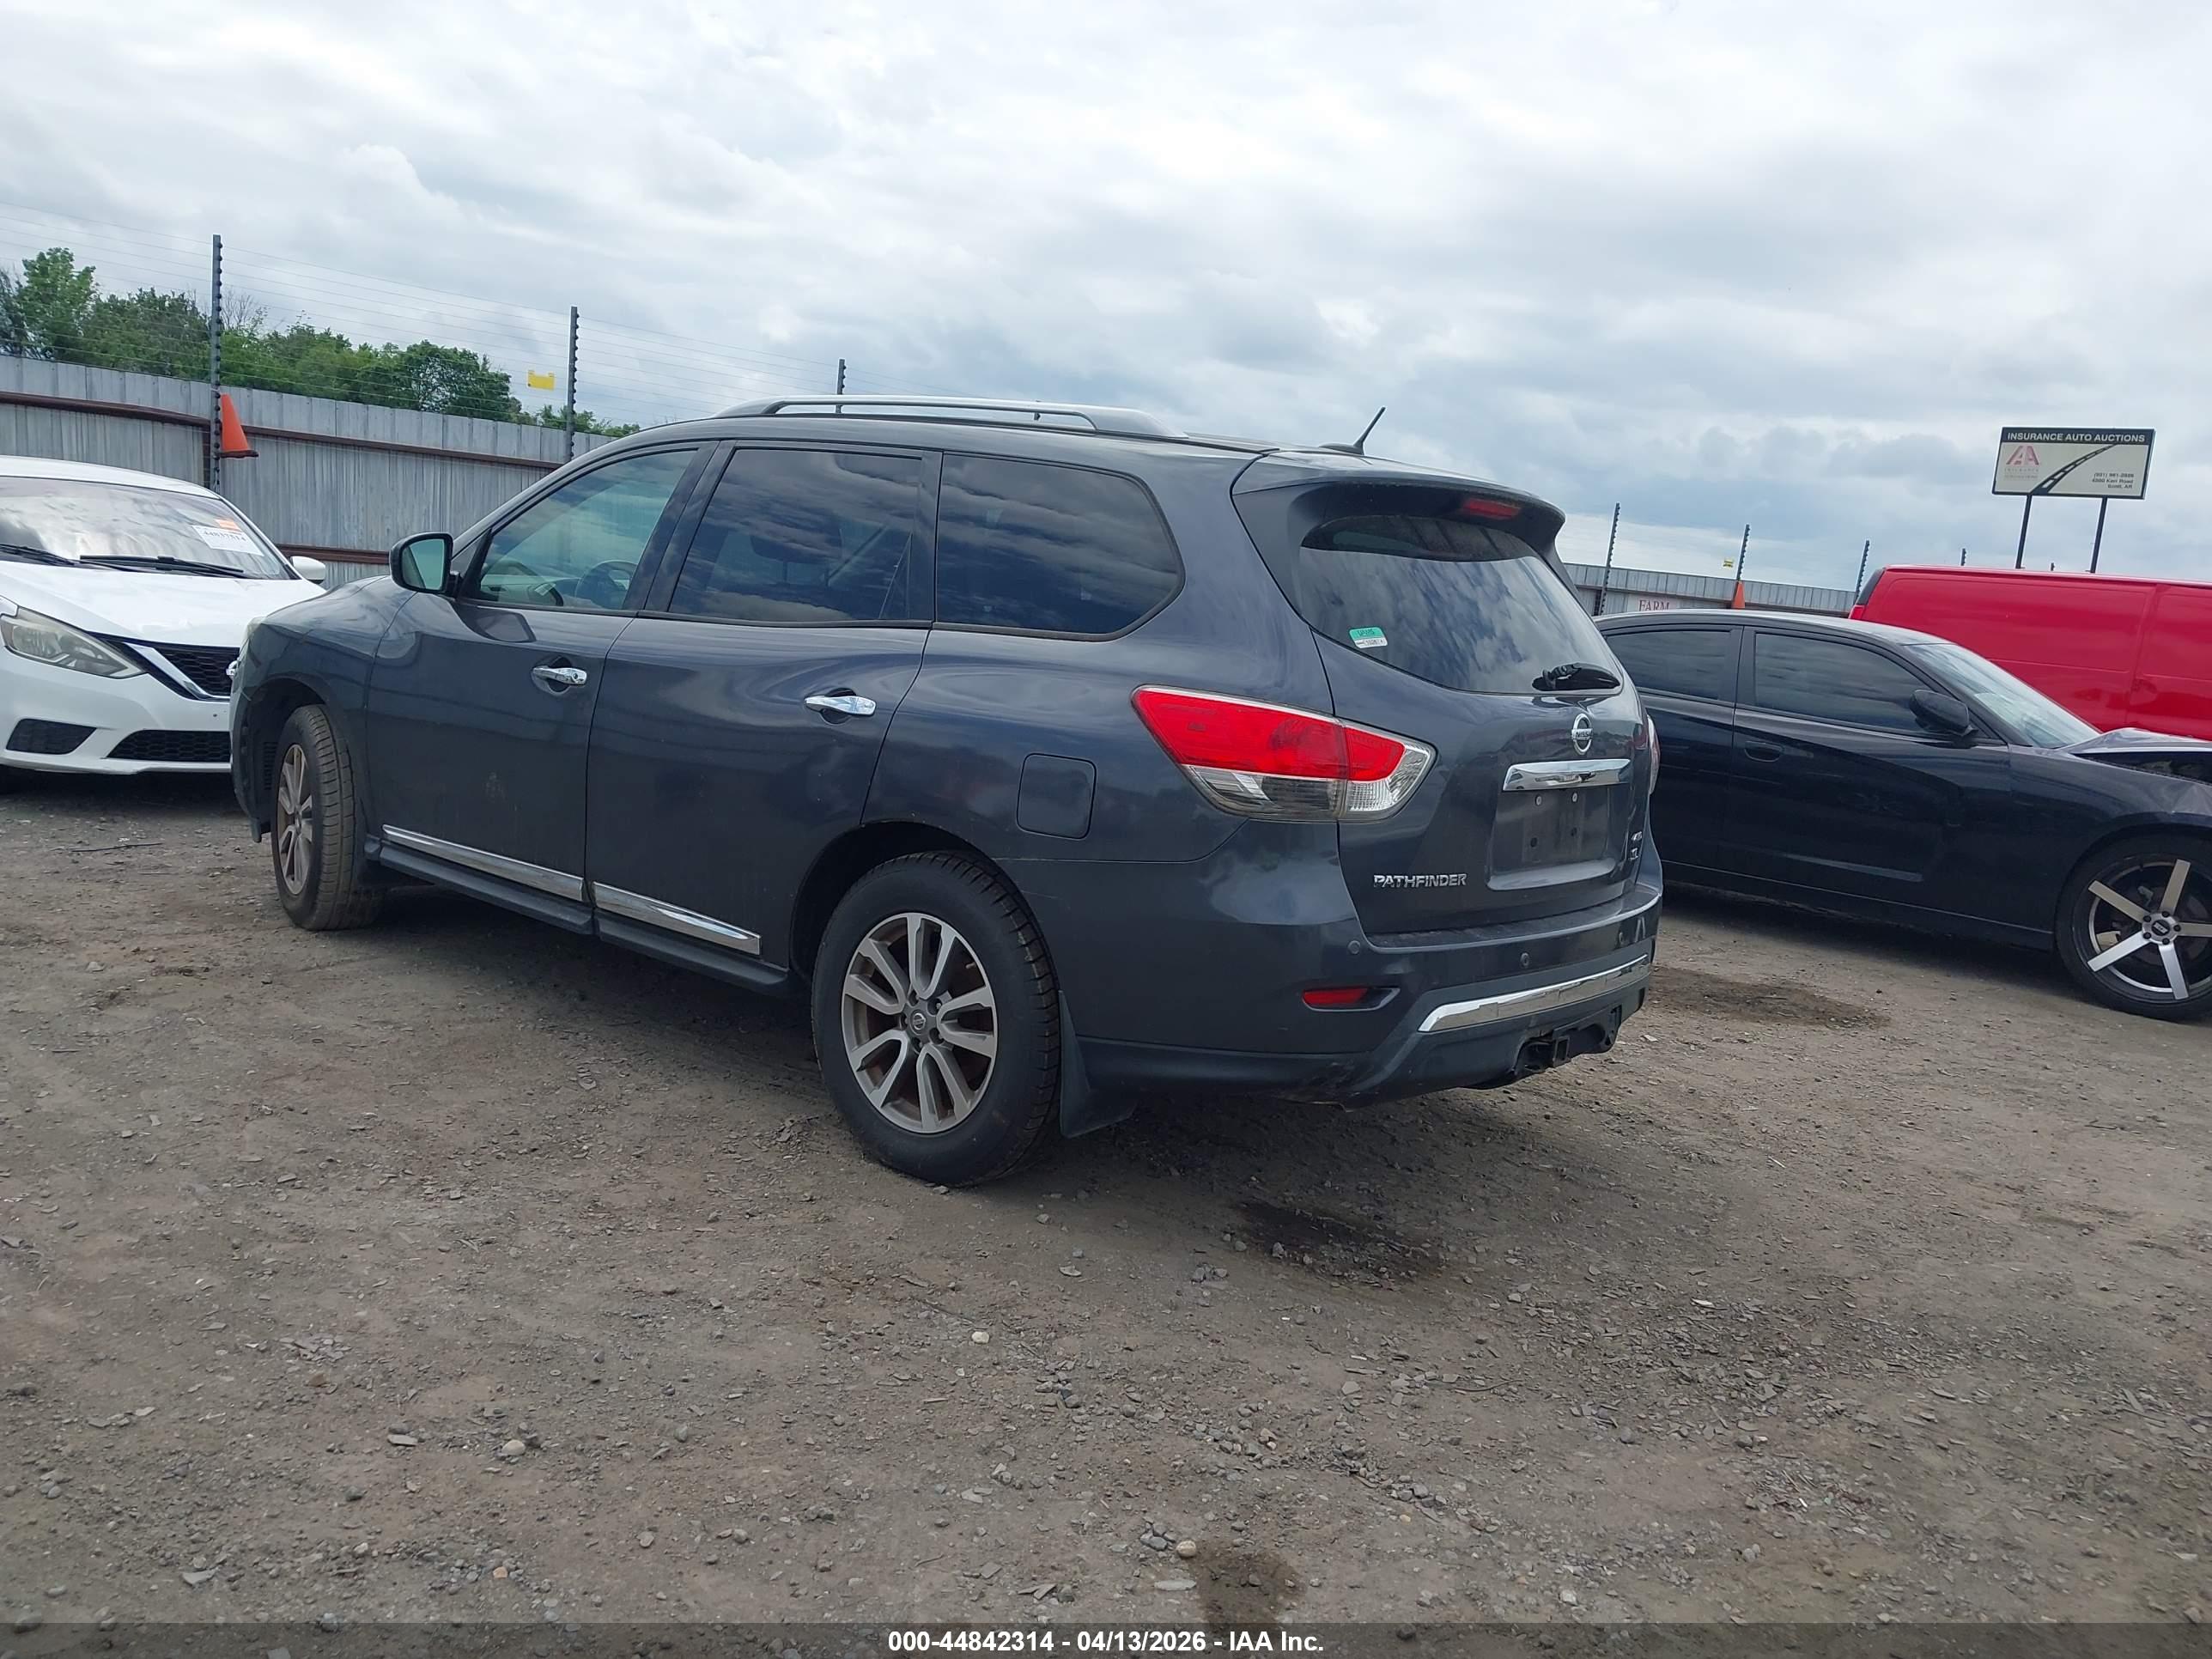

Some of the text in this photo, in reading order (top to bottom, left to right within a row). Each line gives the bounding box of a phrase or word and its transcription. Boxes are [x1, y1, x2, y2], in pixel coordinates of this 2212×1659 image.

[2007, 432, 2146, 443] INSURANCE AUTO AUCTIONS
[1638, 599, 1670, 611] FARM
[1373, 873, 1468, 888] PATHFINDER
